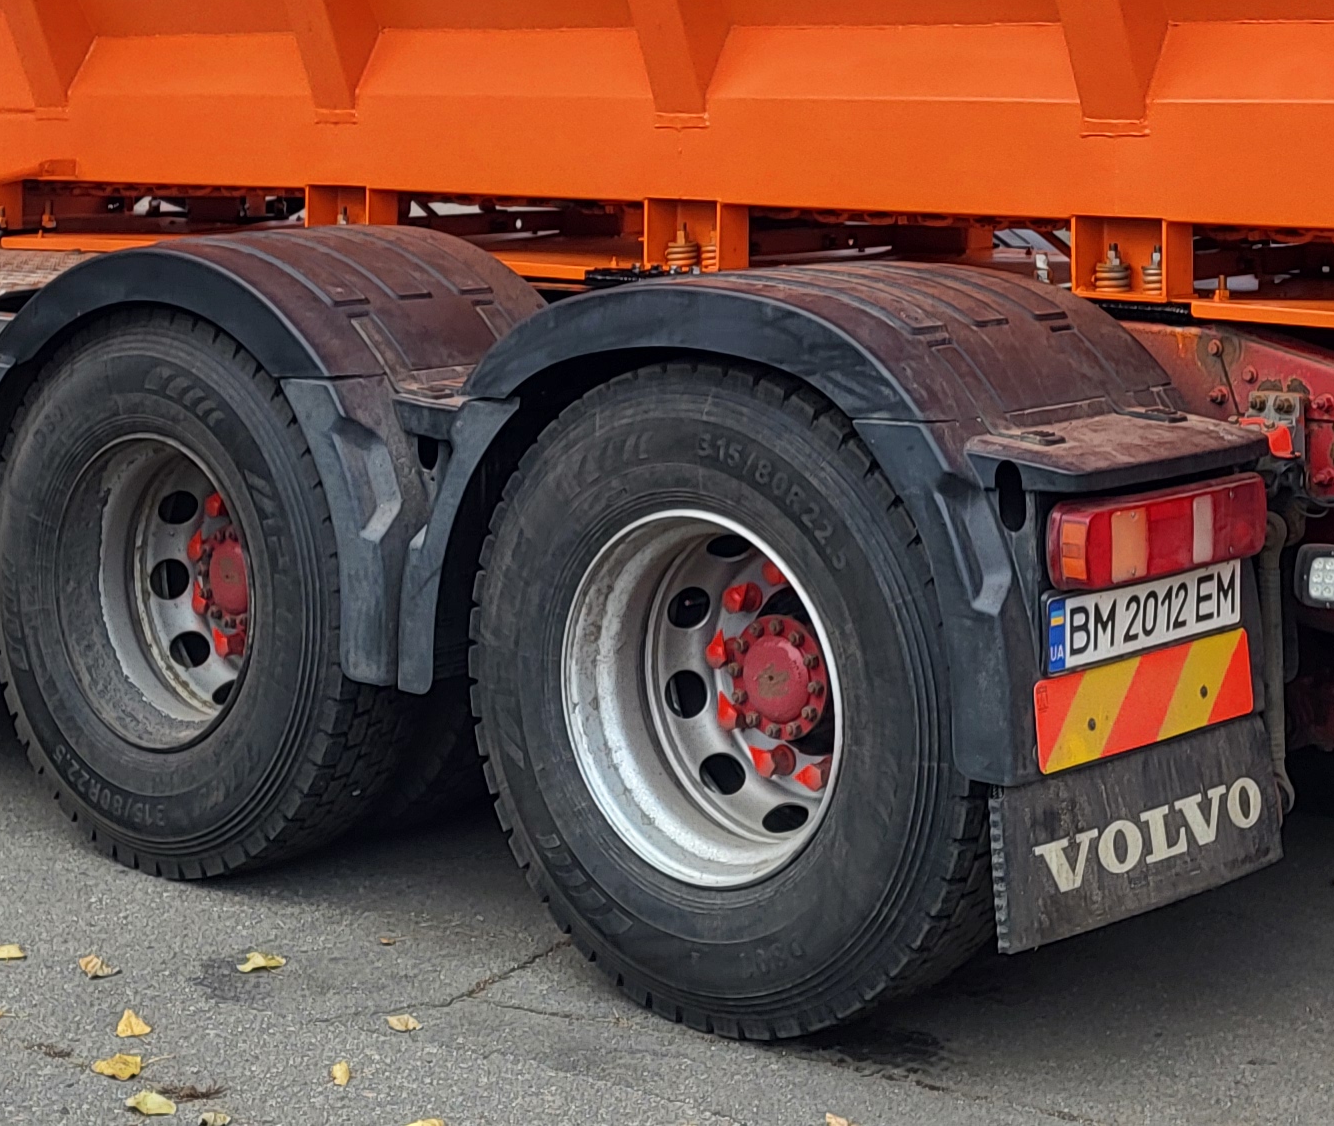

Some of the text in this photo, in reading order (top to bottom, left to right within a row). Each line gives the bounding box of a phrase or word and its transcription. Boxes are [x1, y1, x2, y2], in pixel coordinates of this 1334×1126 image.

[1050, 644, 1065, 662] UA
[1069, 564, 1236, 658] BM 2012 EM
[1033, 777, 1262, 893] VOLVO
